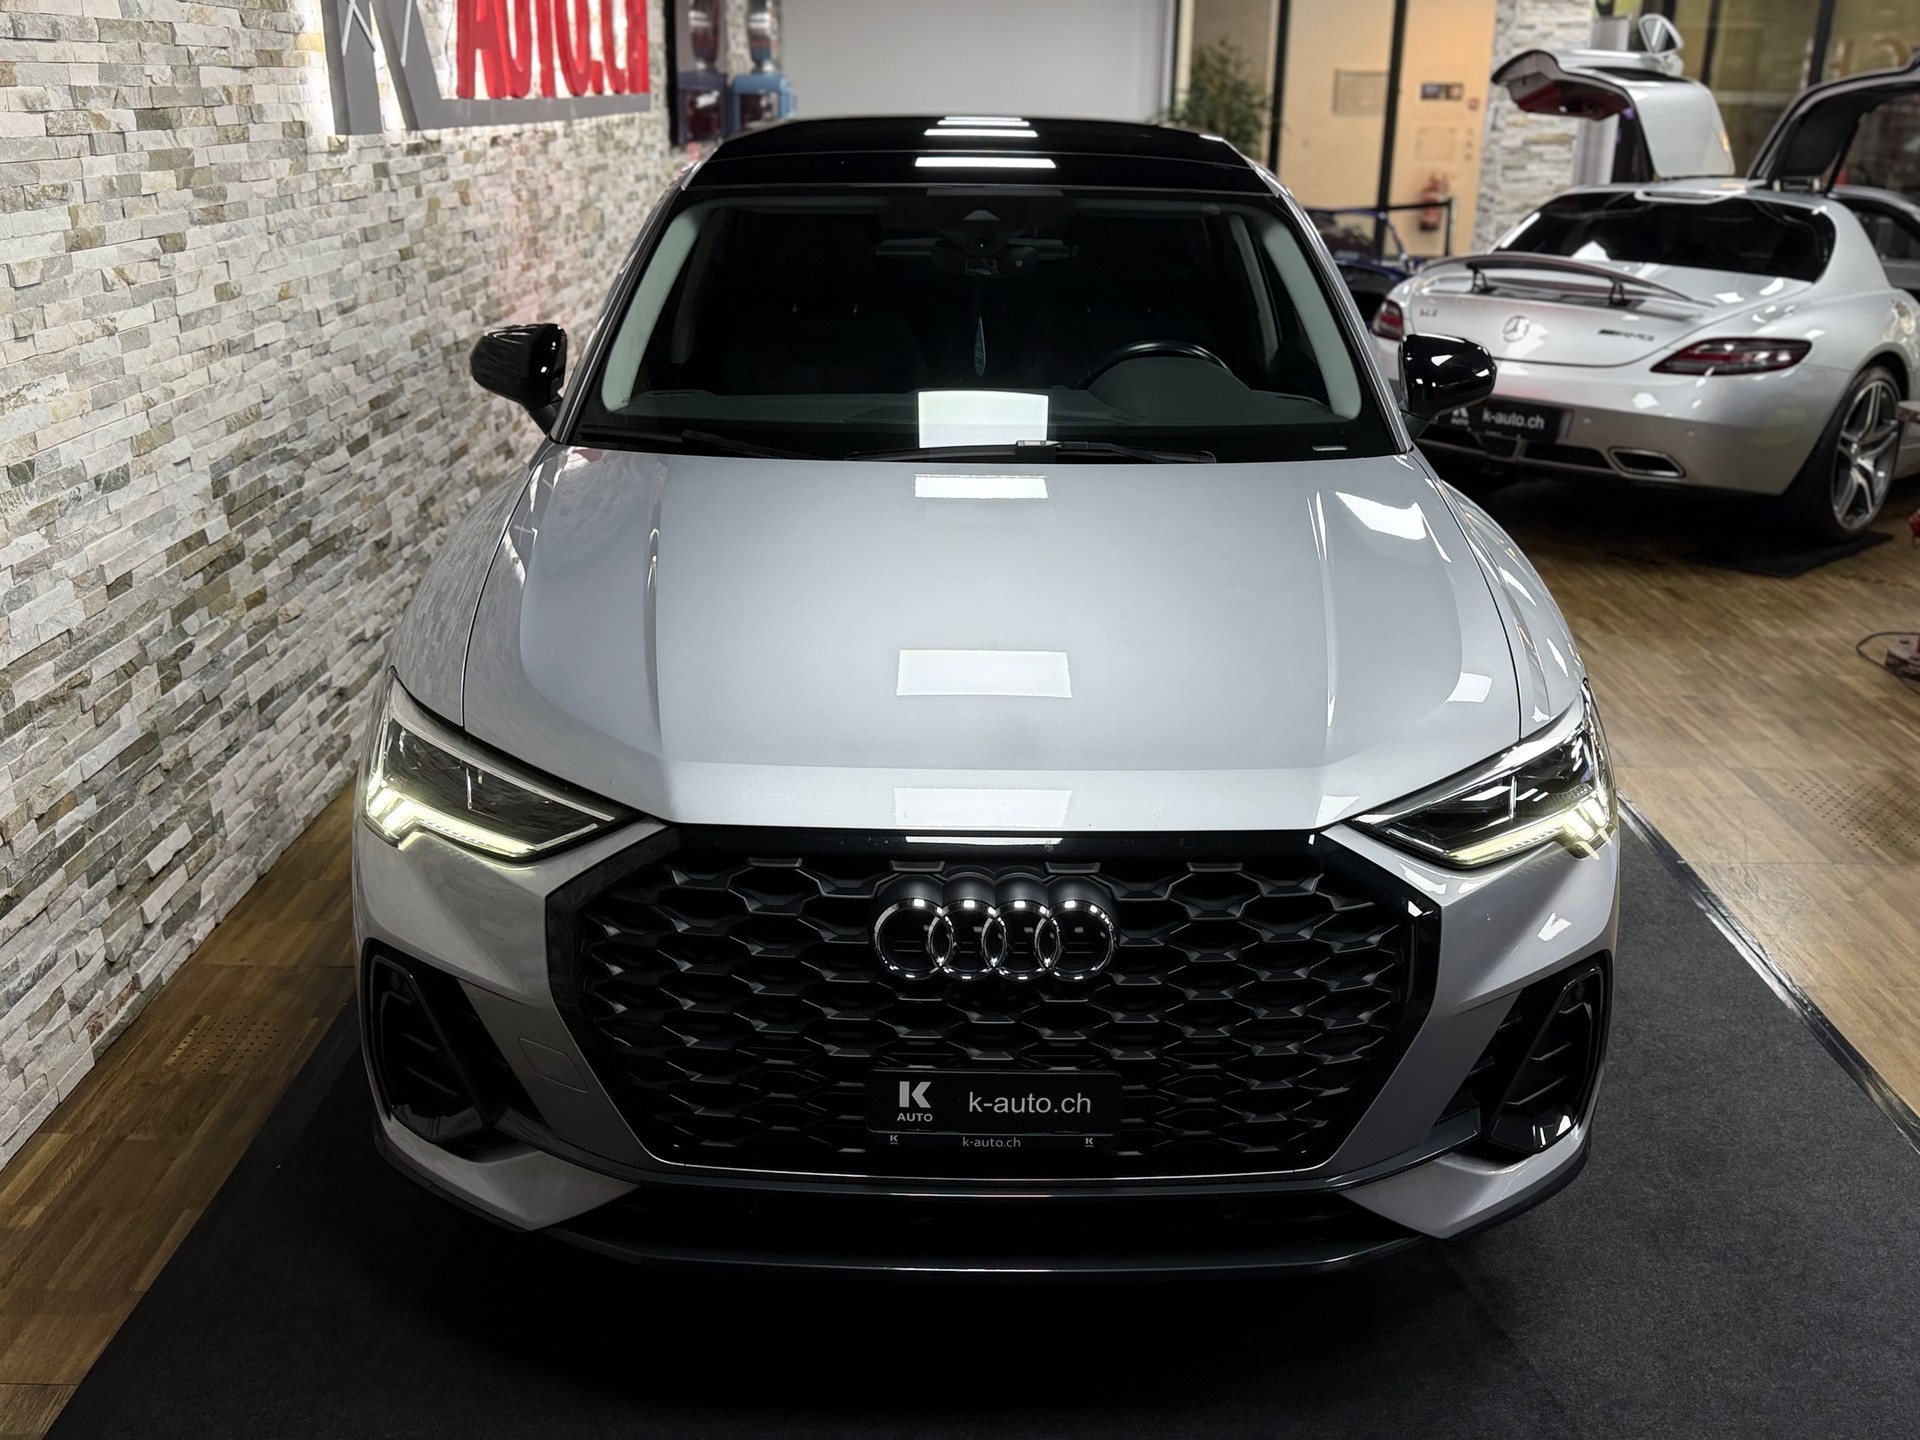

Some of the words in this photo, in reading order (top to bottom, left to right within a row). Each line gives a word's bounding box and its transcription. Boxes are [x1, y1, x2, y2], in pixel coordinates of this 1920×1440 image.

[1482, 408, 1546, 430] k-auto.ch
[898, 1080, 932, 1109] K
[968, 1091, 1092, 1114] k-auto.ch
[897, 1112, 933, 1123] AUTO
[962, 1136, 1022, 1148] k-auto.ch
